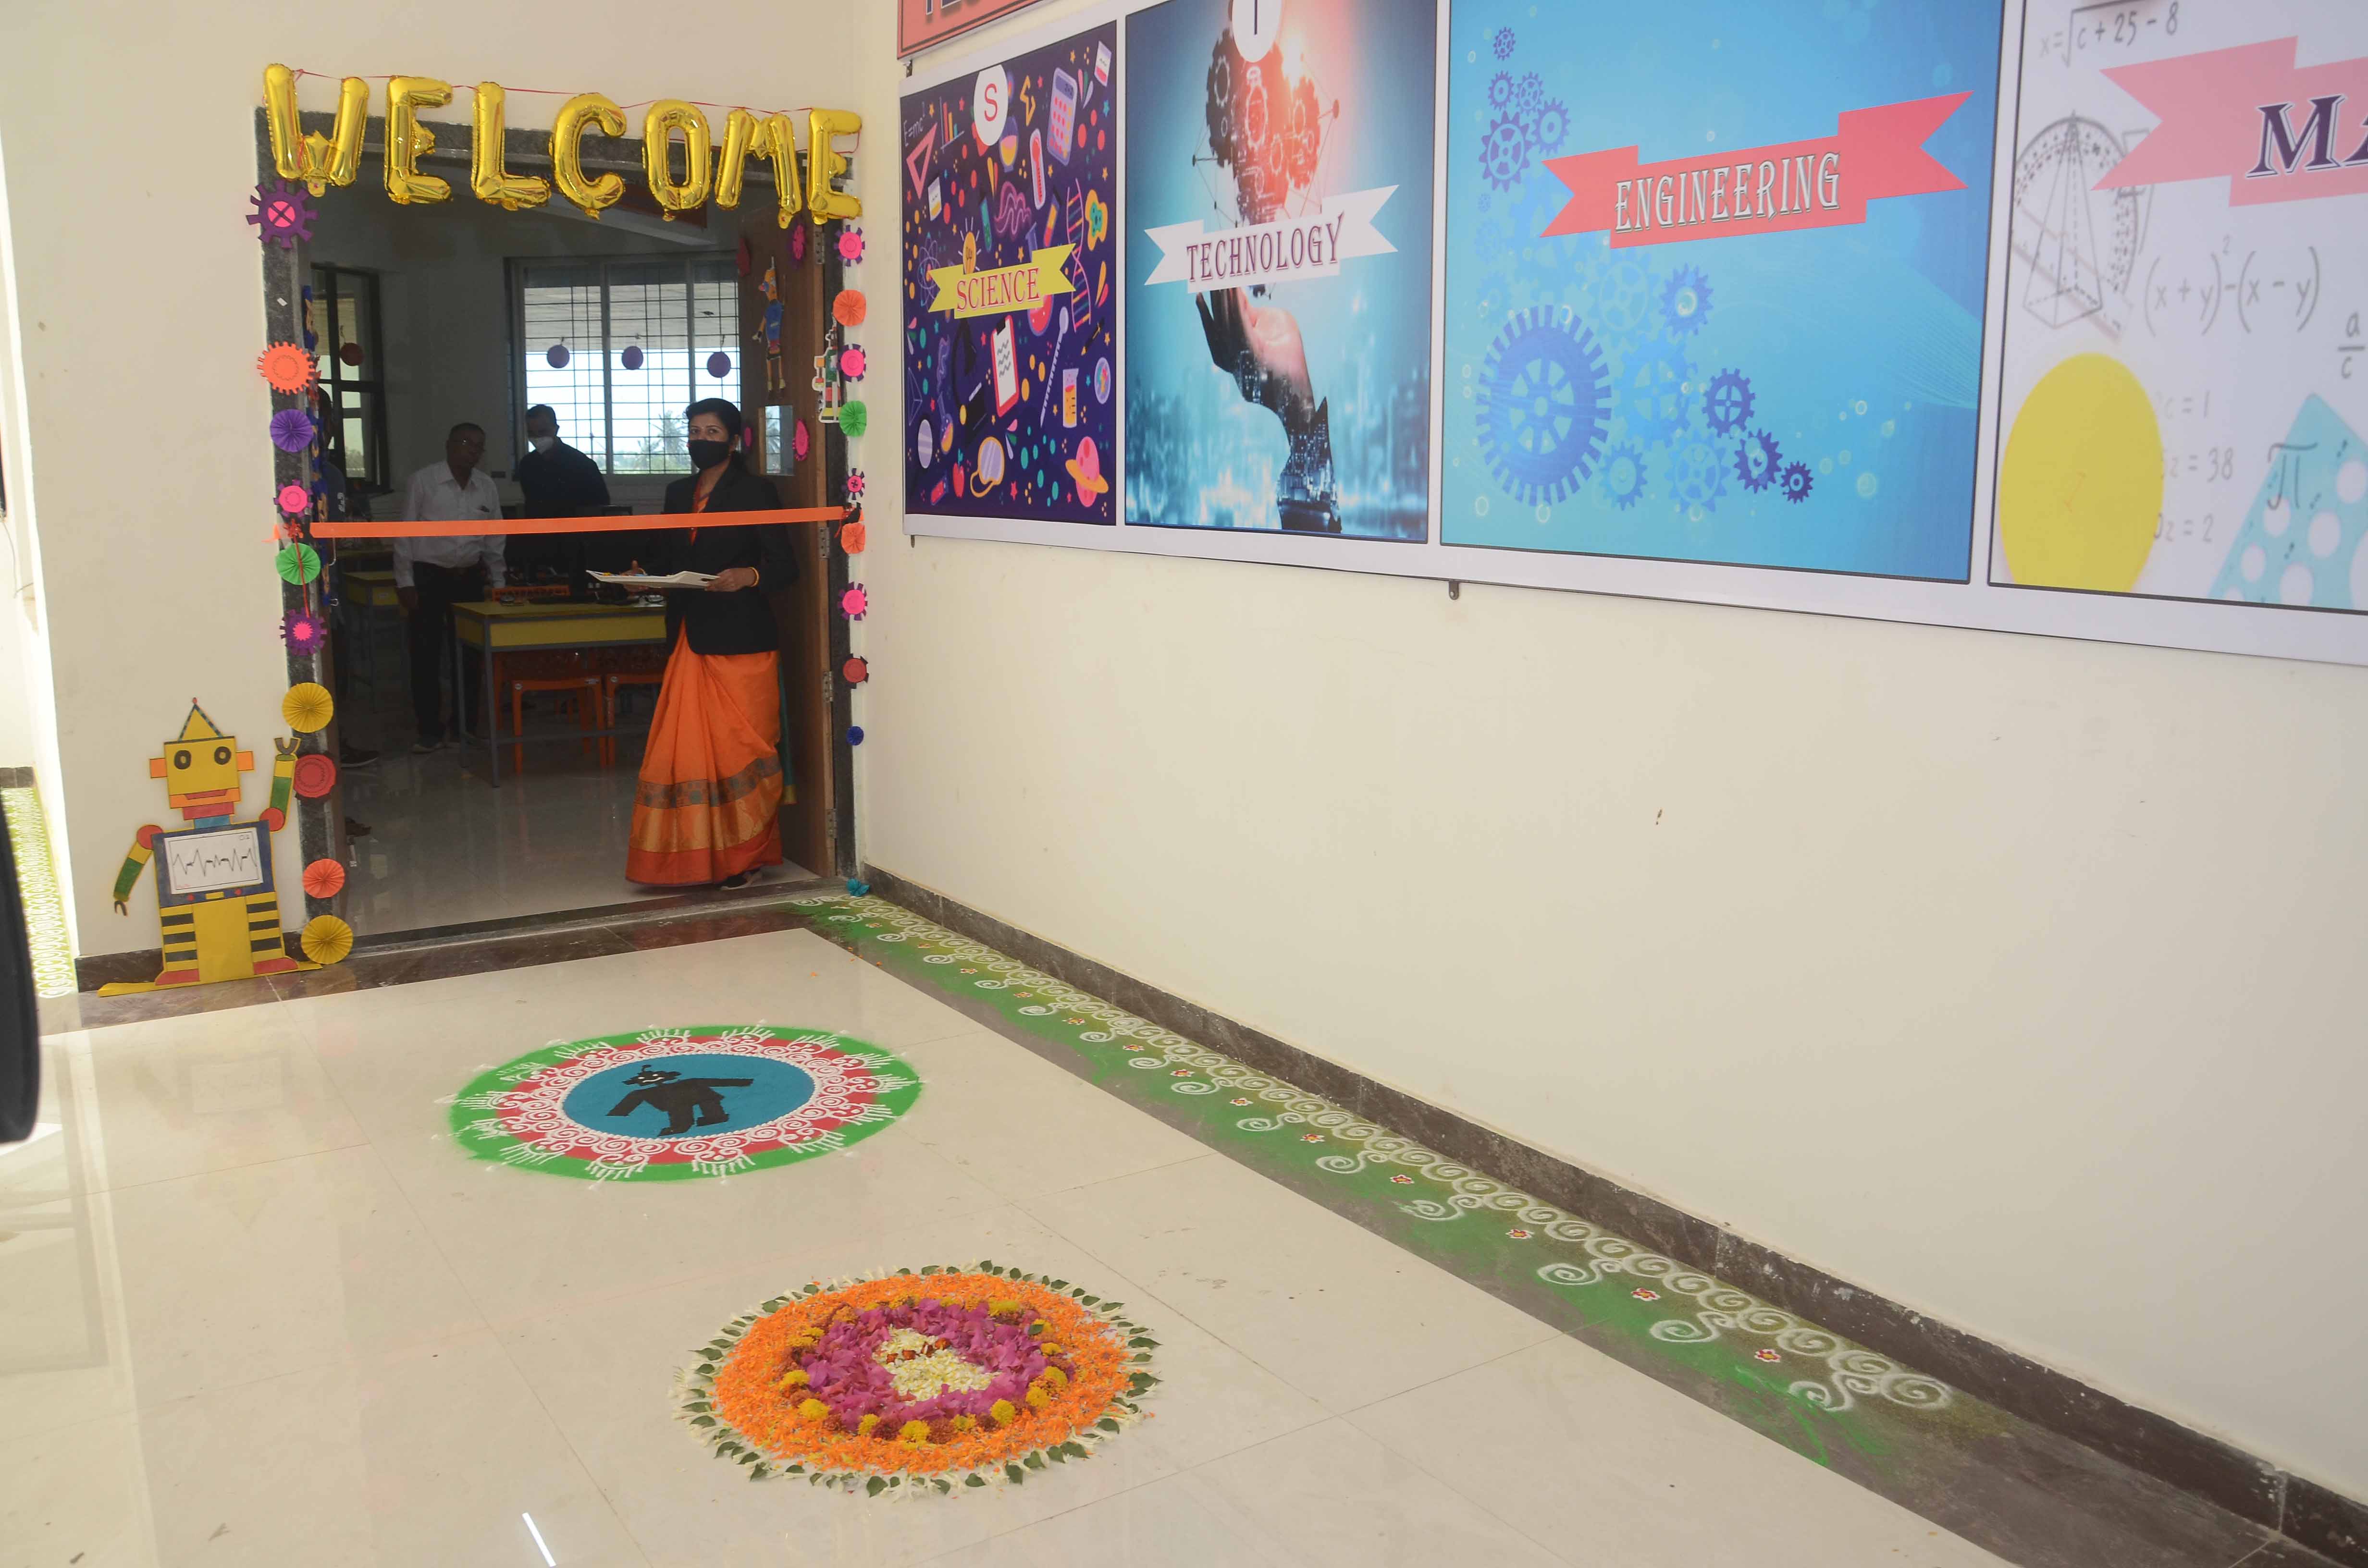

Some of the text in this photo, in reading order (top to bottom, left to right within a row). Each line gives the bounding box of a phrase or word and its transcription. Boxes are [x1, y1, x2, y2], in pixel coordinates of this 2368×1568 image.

[984, 83, 998, 122] S
[263, 63, 863, 227] WELCOME
[1615, 151, 1840, 234] ENGINEERING
[1186, 211, 1345, 282] TECHNOLOGY
[957, 268, 1041, 311] SCIENCE
